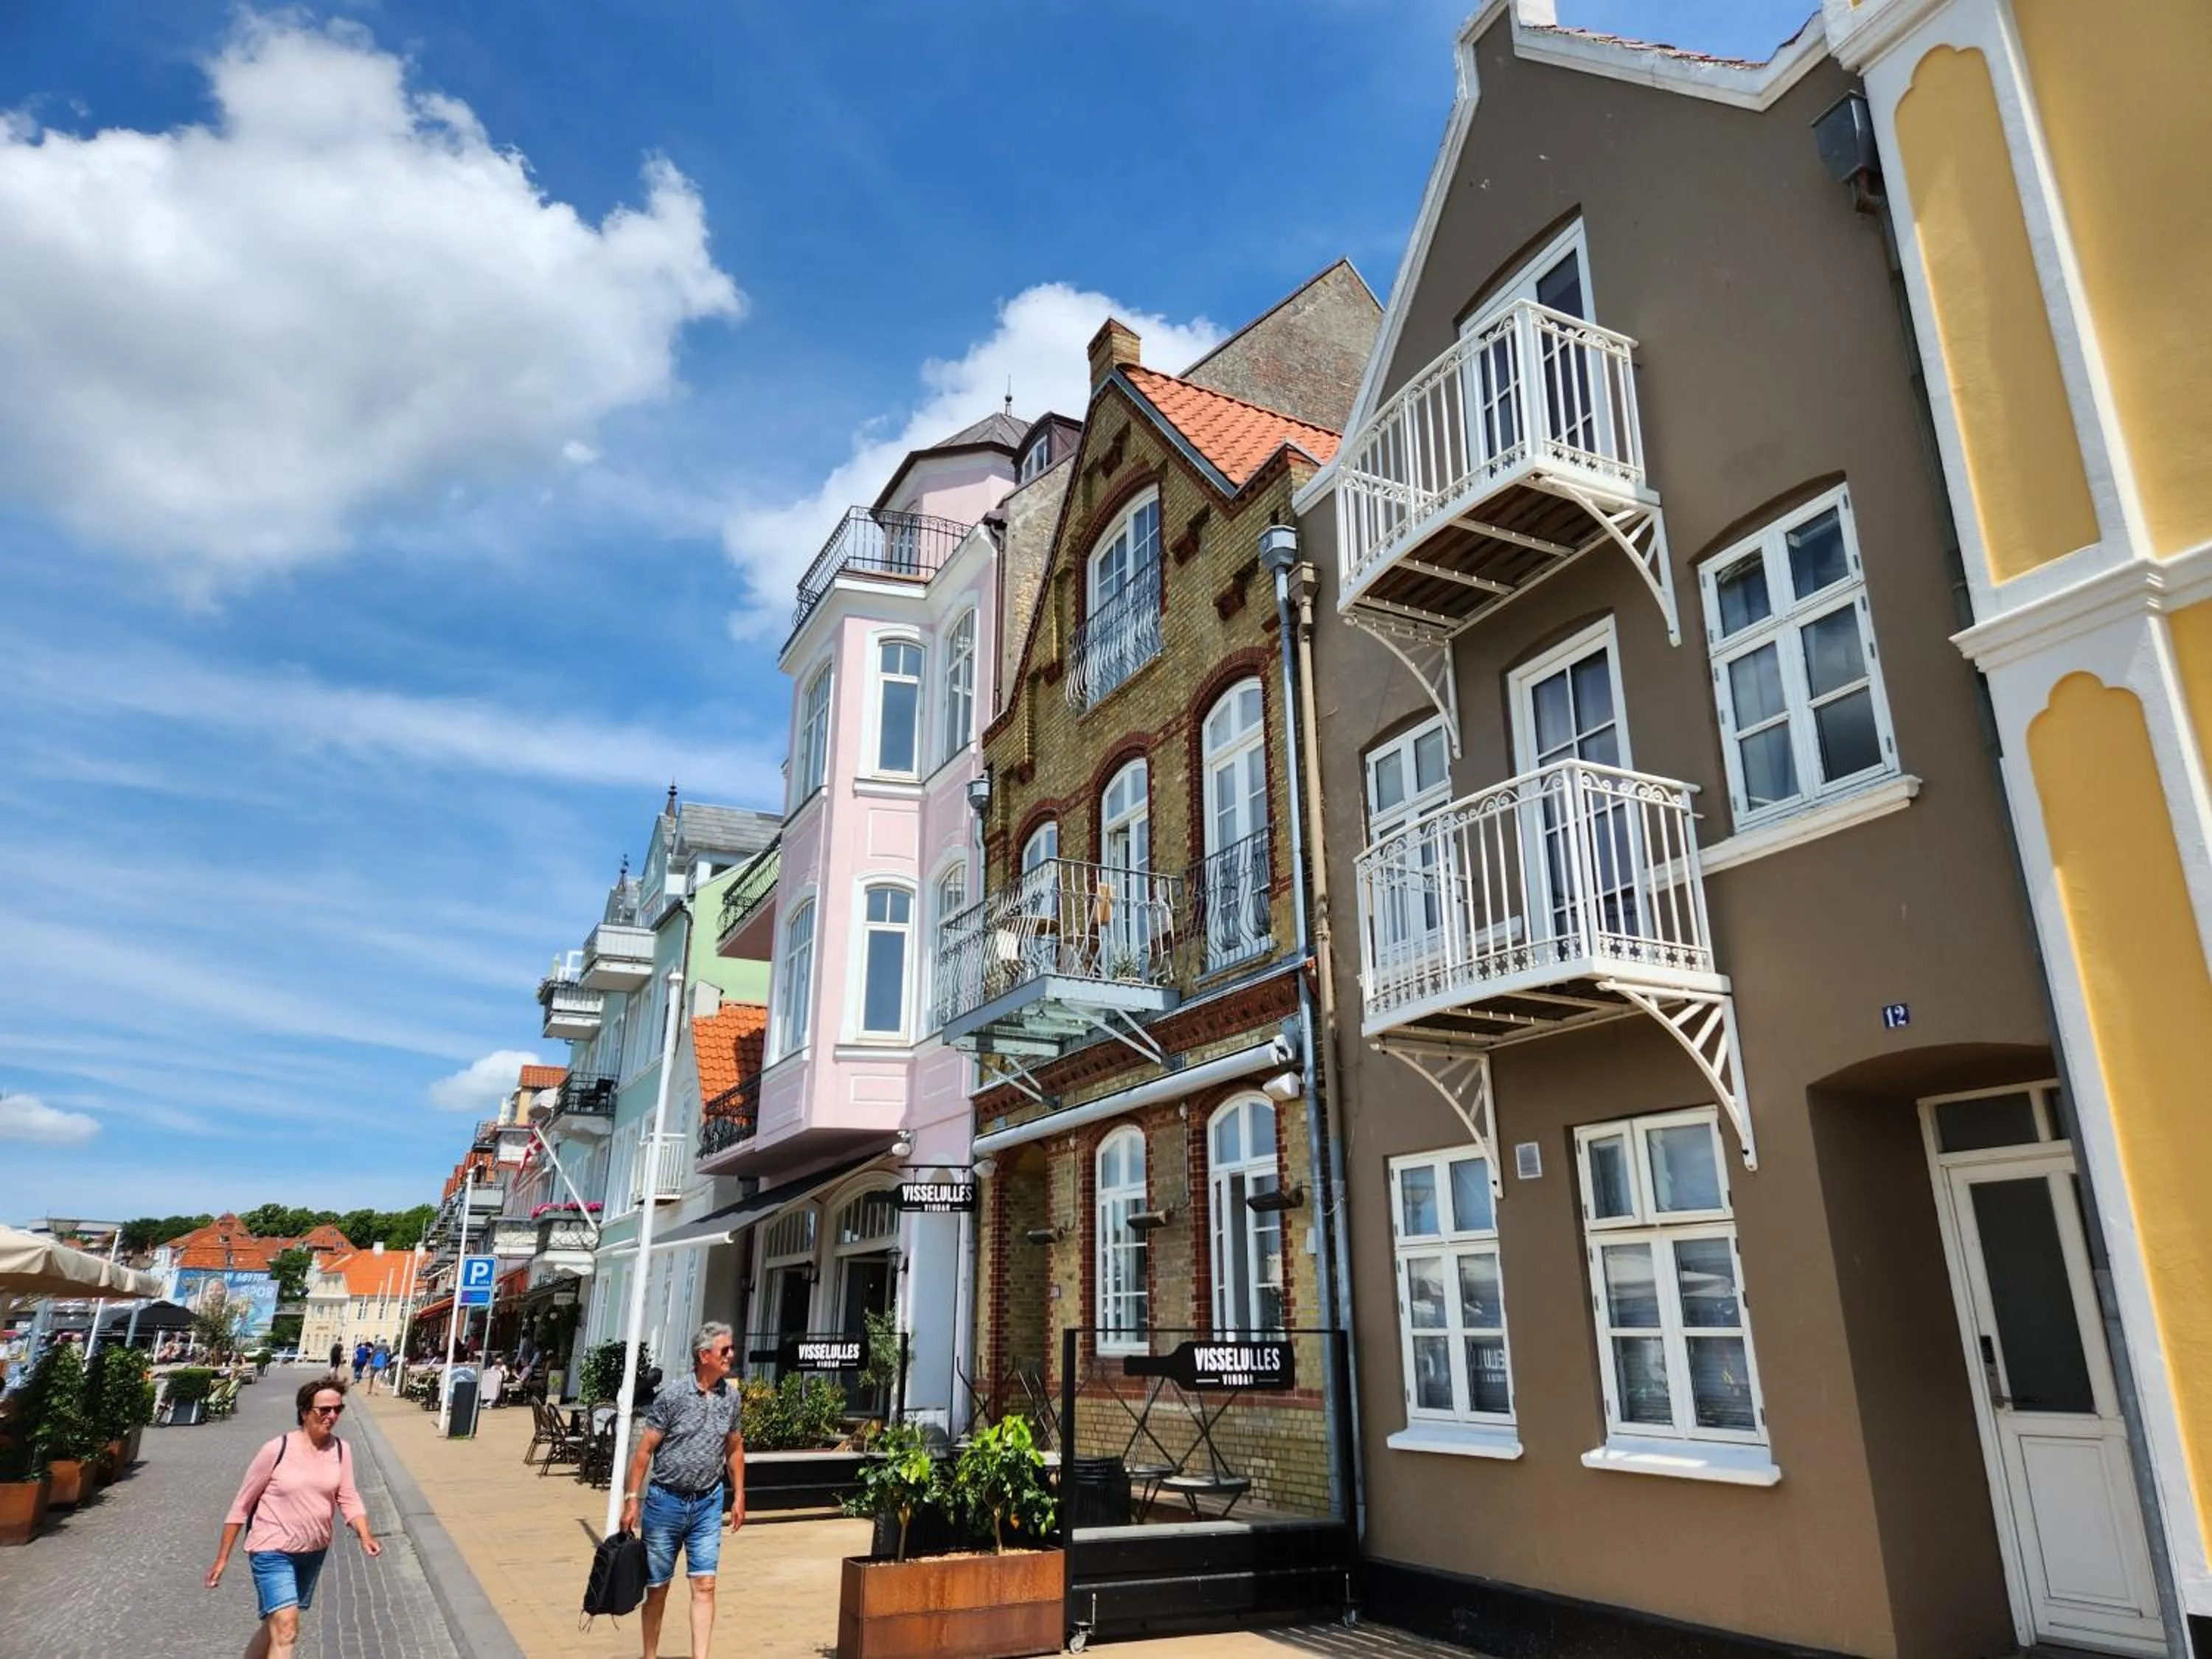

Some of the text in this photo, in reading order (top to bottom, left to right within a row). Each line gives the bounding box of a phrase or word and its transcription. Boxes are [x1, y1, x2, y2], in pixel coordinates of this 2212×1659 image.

[1886, 1005, 1906, 1026] 12
[902, 1185, 973, 1202] VISSELULLES
[470, 1262, 489, 1284] P
[799, 1343, 860, 1360] VISSELULLES
[1194, 1347, 1281, 1371] VISSELULLES
